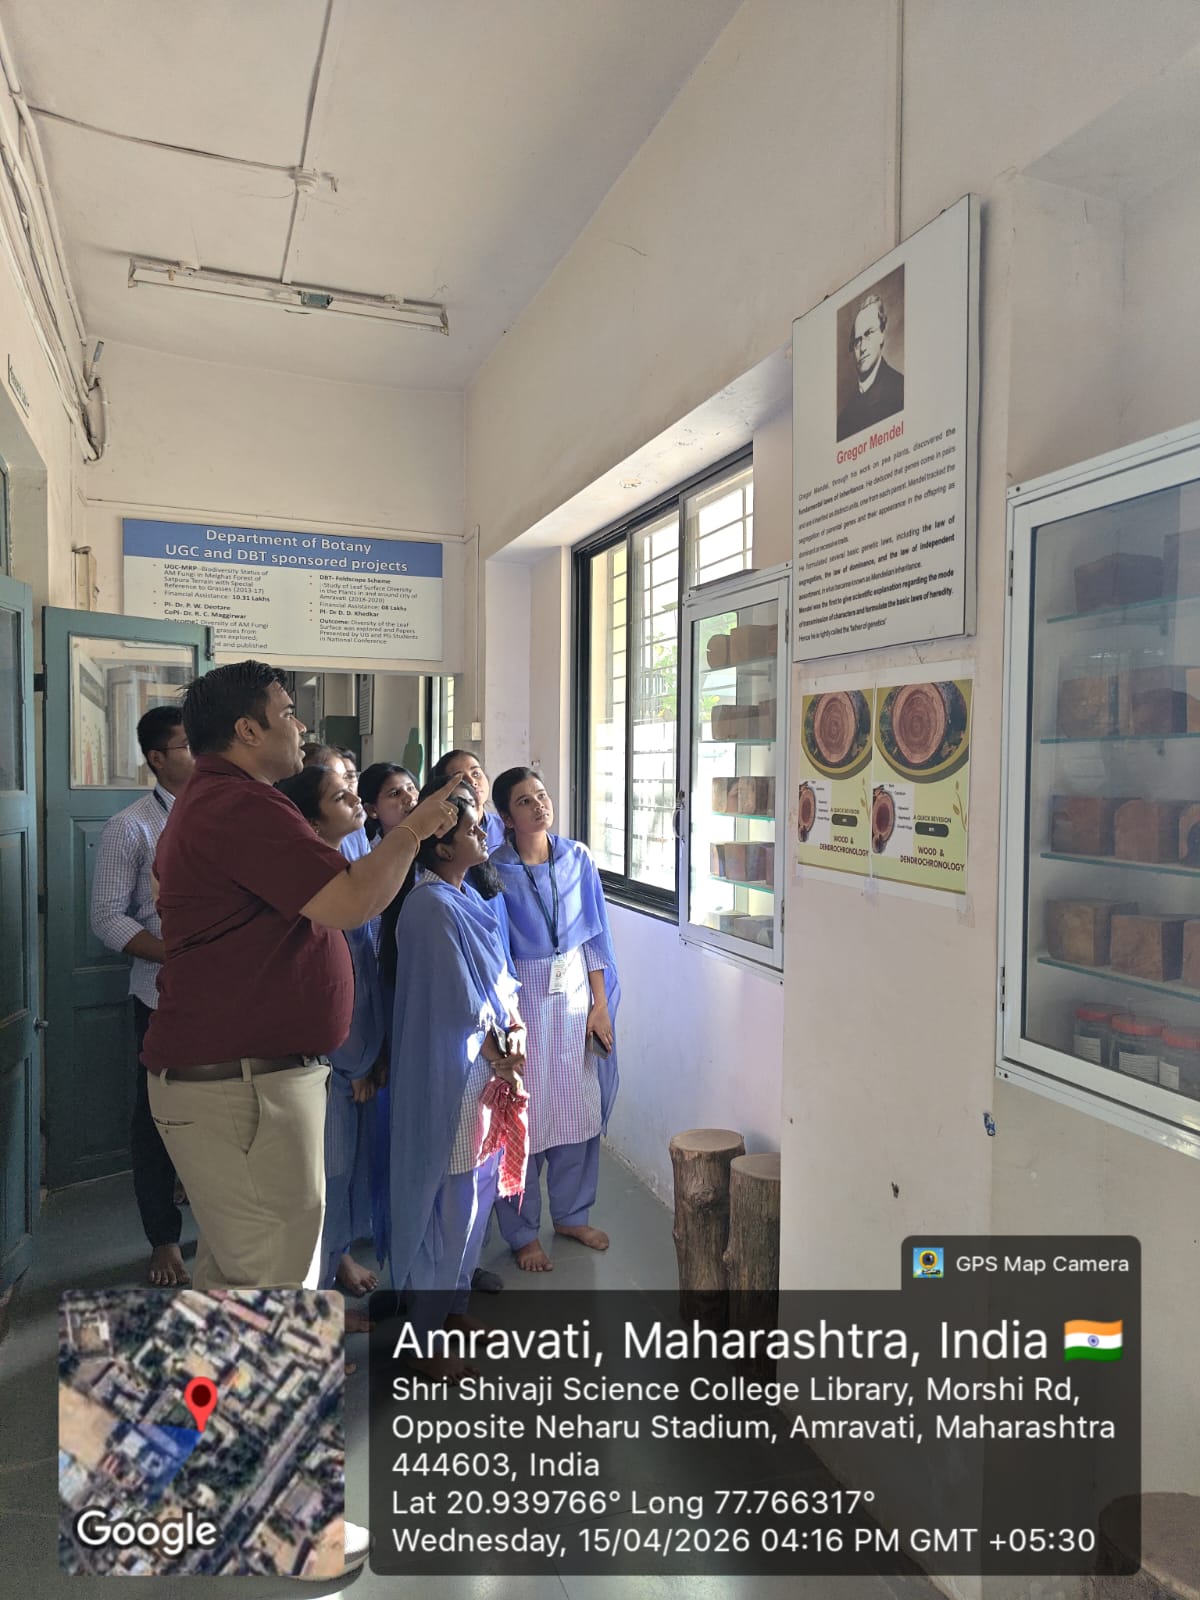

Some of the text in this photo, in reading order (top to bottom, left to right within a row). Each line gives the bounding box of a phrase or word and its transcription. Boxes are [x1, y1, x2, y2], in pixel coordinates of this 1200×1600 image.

[837, 420, 904, 464] Gregor Mendel
[206, 529, 371, 554] Department of Botany
[165, 543, 407, 574] UGC and DBT sponsored projects
[820, 843, 868, 856] DENDROCHRONOLOGY
[918, 846, 944, 857] WOOD &
[900, 855, 965, 872] DENDROCHRONOLOGY
